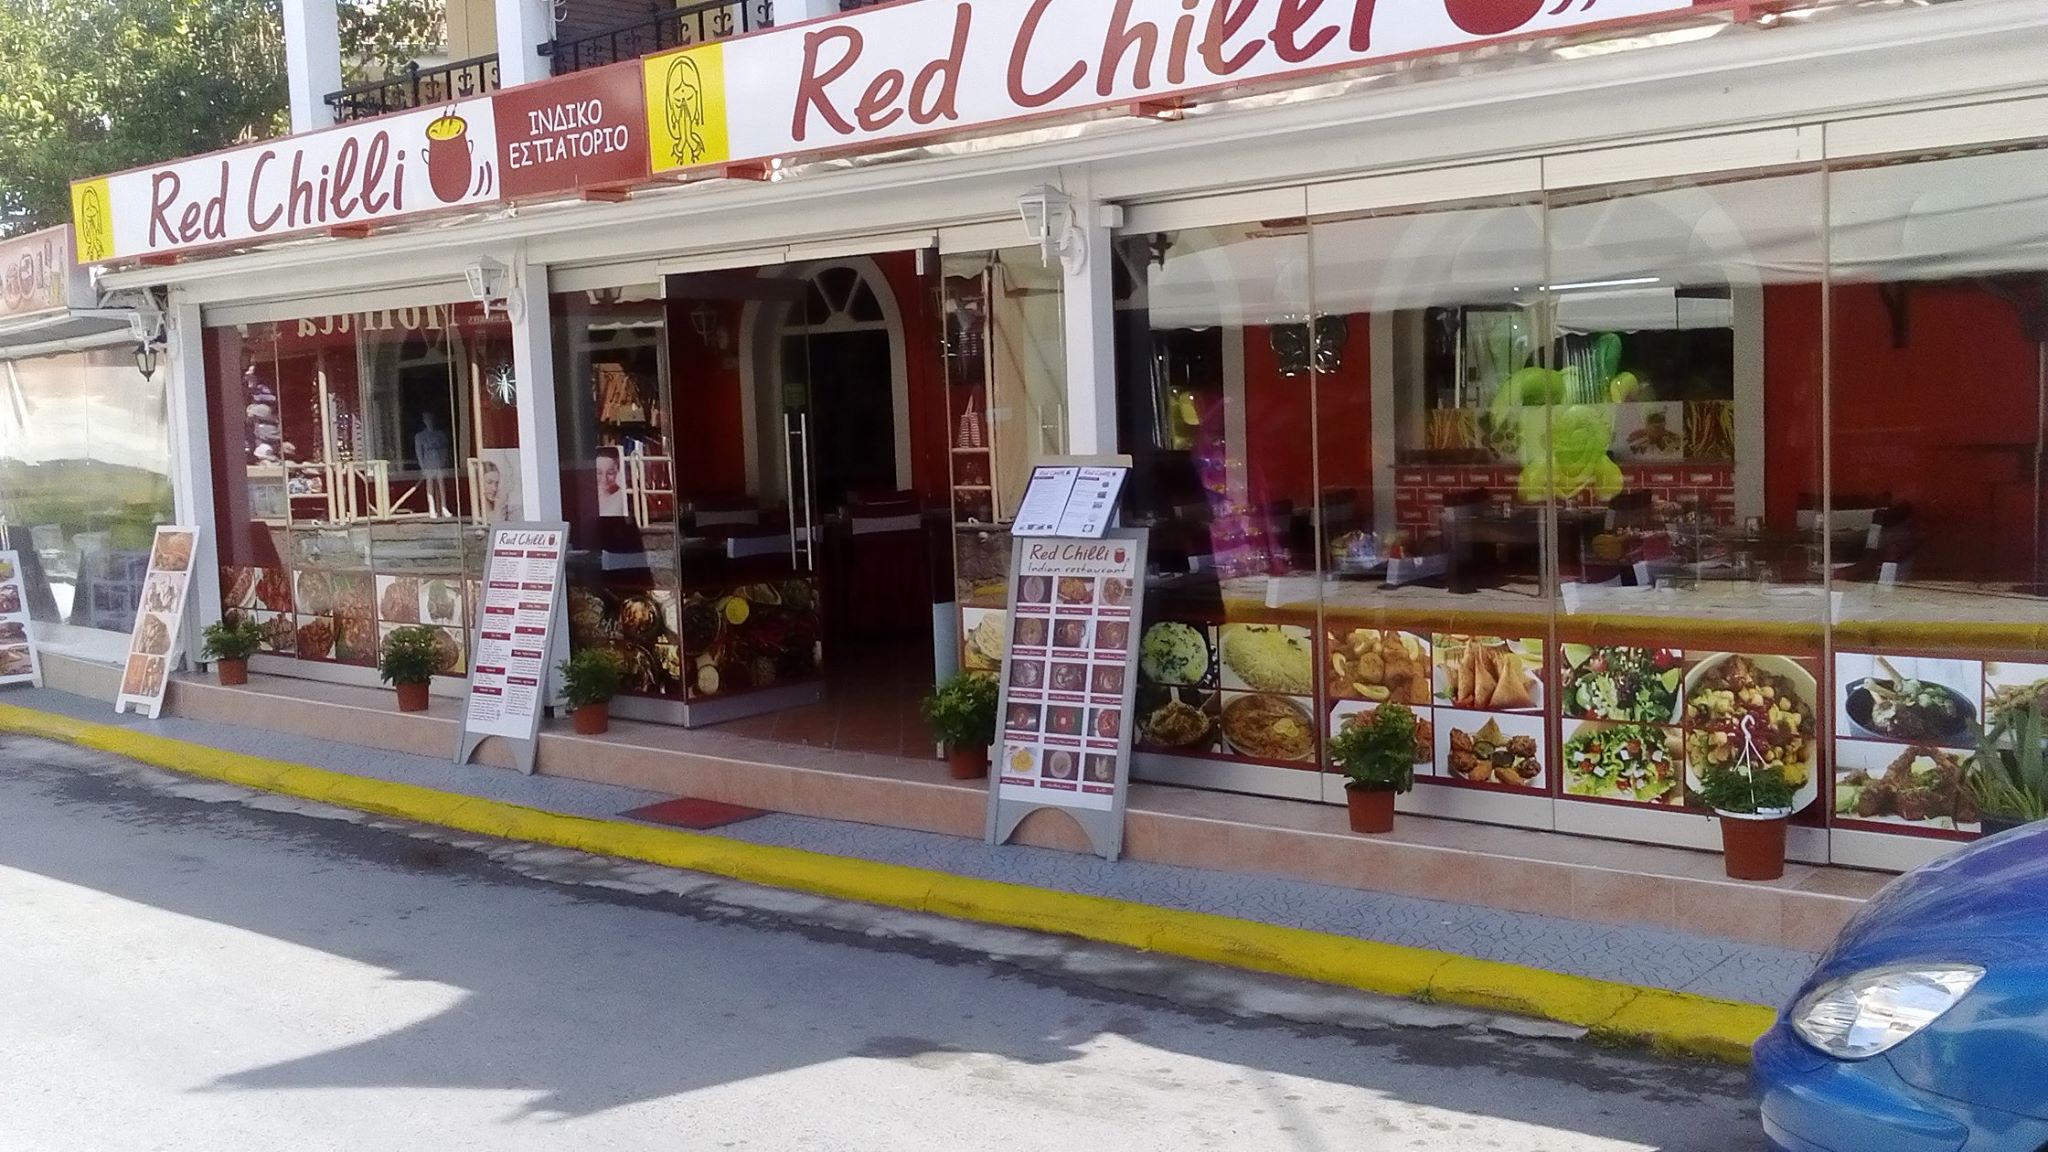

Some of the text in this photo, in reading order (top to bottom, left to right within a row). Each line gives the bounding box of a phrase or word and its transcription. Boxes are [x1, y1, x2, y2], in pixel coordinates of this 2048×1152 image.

[792, 2, 972, 142] Red
[528, 99, 602, 136] ΙΝΔΙΚΟ
[509, 125, 629, 169] ΕΣΤΙΑΤΟΡΙΟ
[149, 130, 406, 248] Red Chilli
[499, 532, 546, 546] Red Chilli
[1029, 543, 1110, 561] Red Chilli
[1028, 562, 1128, 574] Indian restaurant
